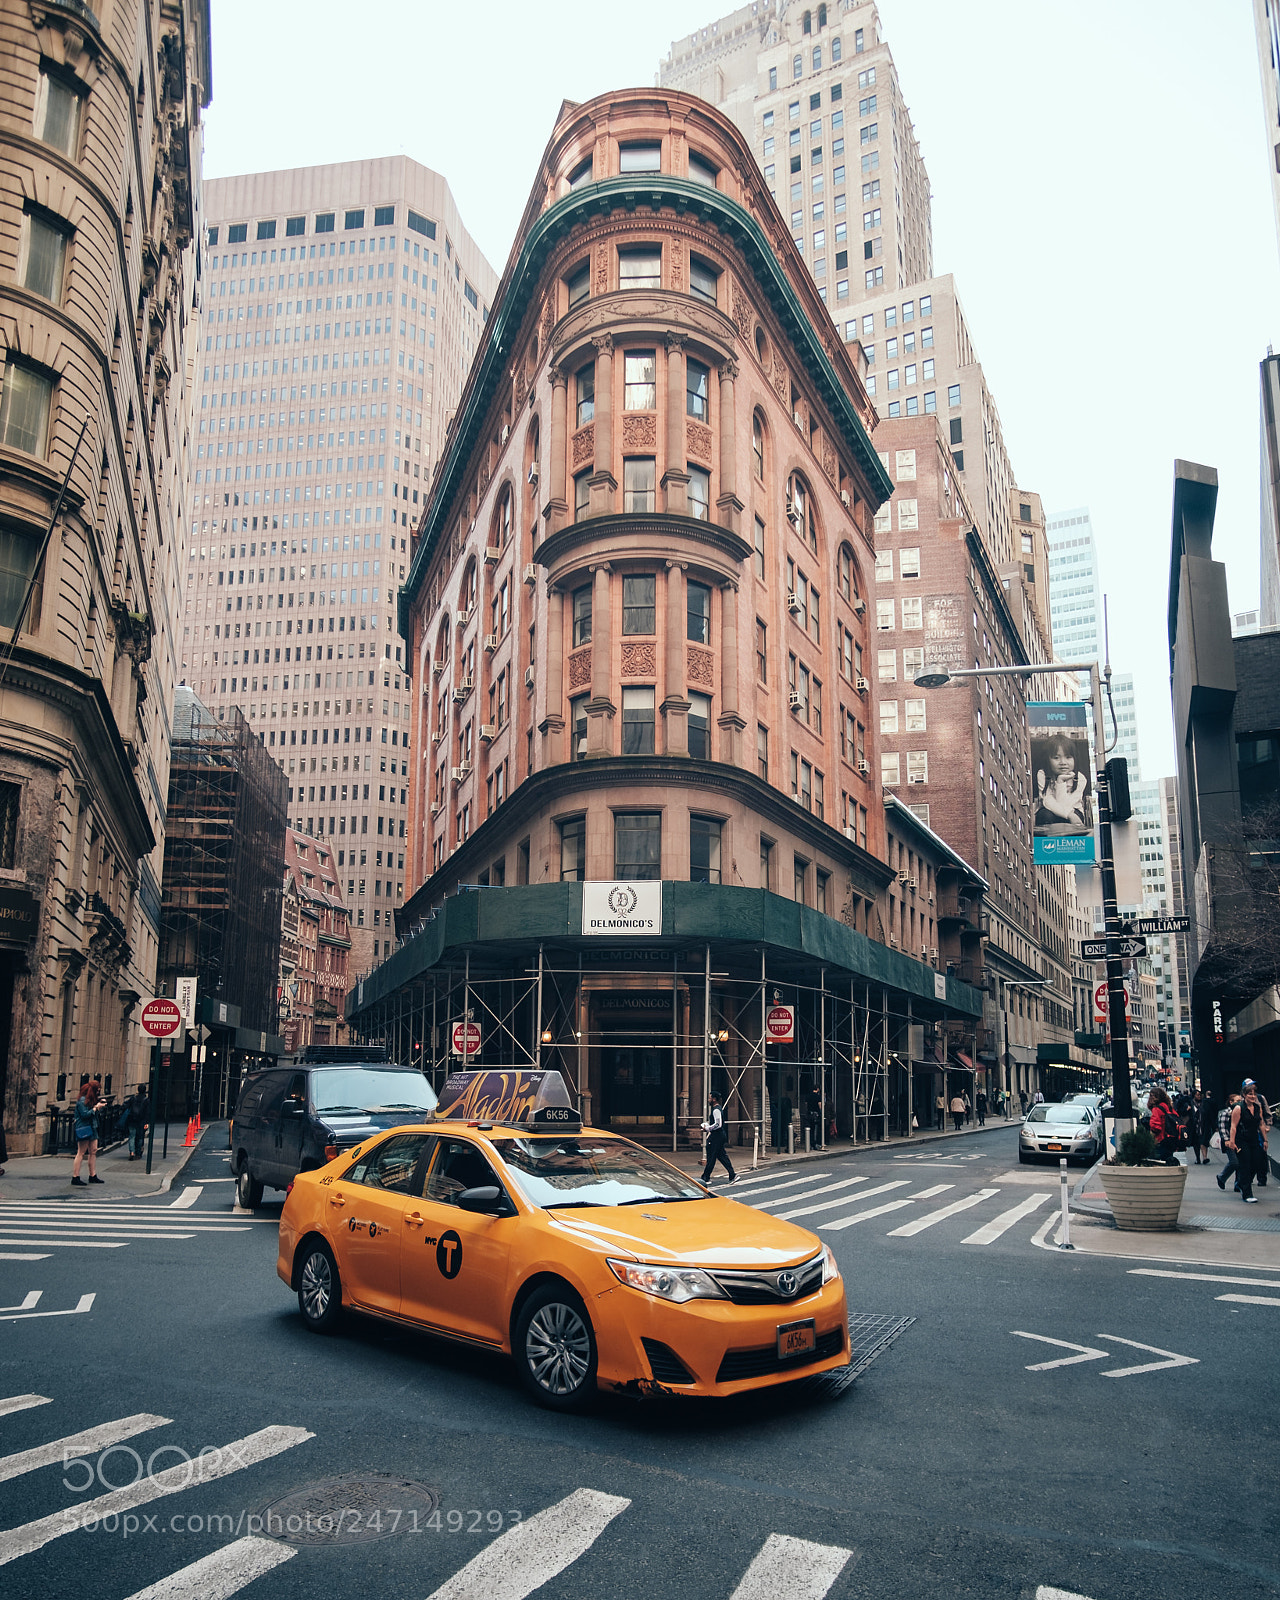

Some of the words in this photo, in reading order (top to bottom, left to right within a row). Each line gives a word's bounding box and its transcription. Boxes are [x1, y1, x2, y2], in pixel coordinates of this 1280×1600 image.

[1046, 713, 1067, 721] NYC
[590, 919, 654, 928] DELMONICO'S
[1140, 920, 1181, 932] WILLIAM
[1086, 945, 1107, 954] ONE
[148, 1005, 159, 1013] DO
[1212, 1000, 1224, 1033] PARK
[149, 1022, 172, 1030] ENTER
[434, 1071, 536, 1122] Aladdin
[546, 1109, 569, 1120] 6K56
[424, 1236, 437, 1246] NYC
